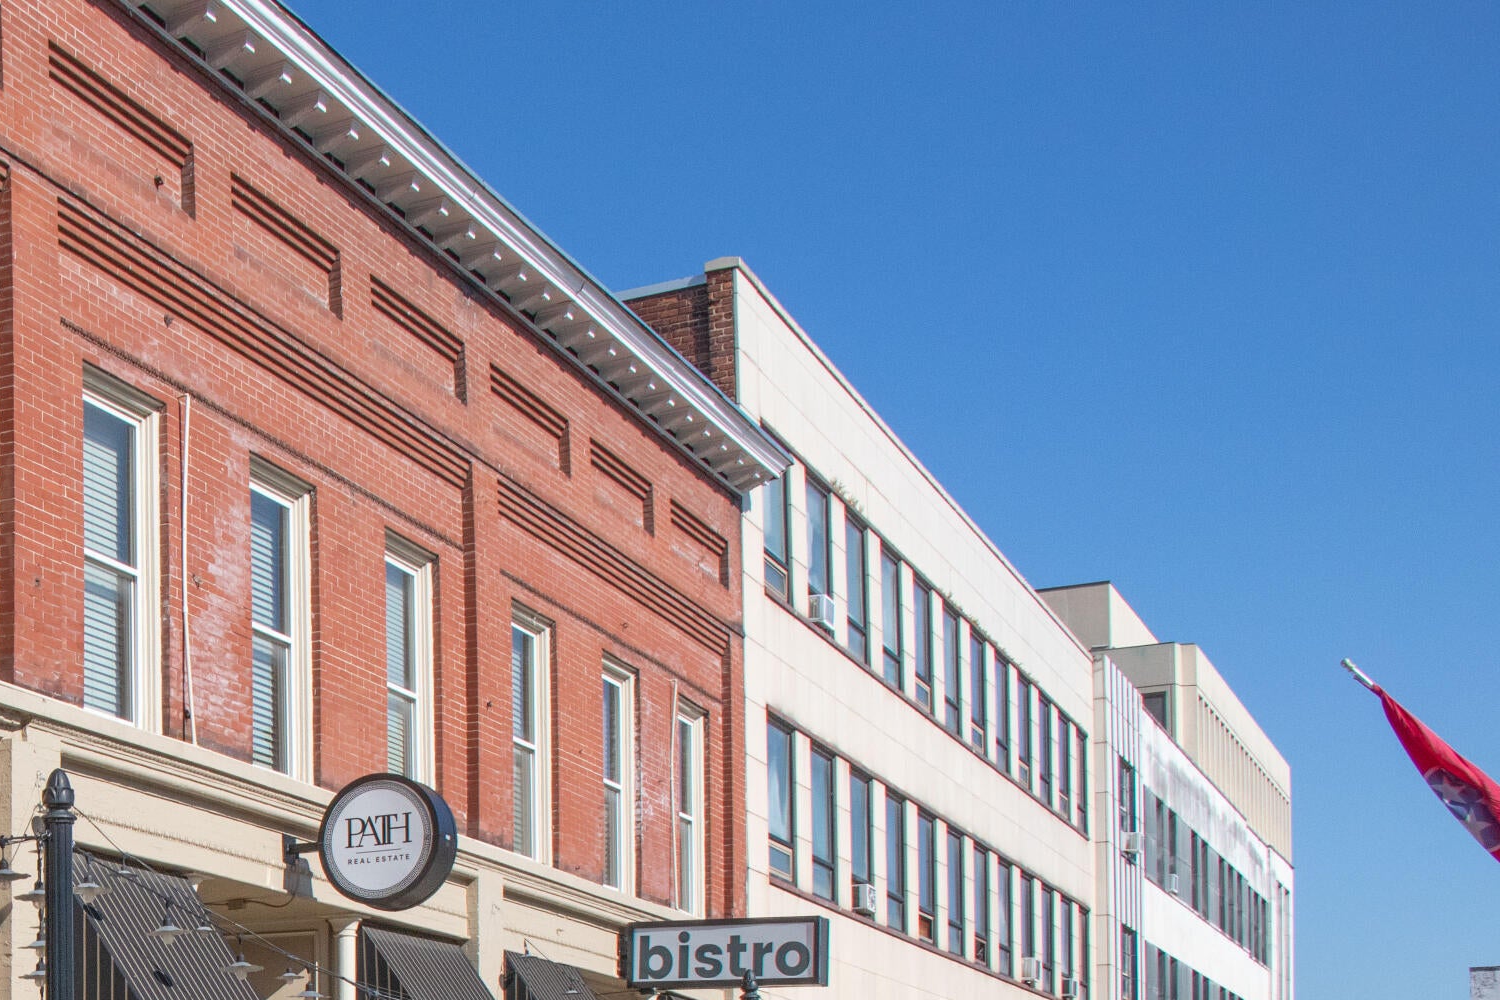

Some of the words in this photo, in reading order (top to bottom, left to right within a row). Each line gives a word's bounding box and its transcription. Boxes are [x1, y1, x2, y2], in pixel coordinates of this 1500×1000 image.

[344, 811, 413, 849] PATH
[376, 854, 411, 863] ESTATE
[638, 931, 810, 980] bistro
